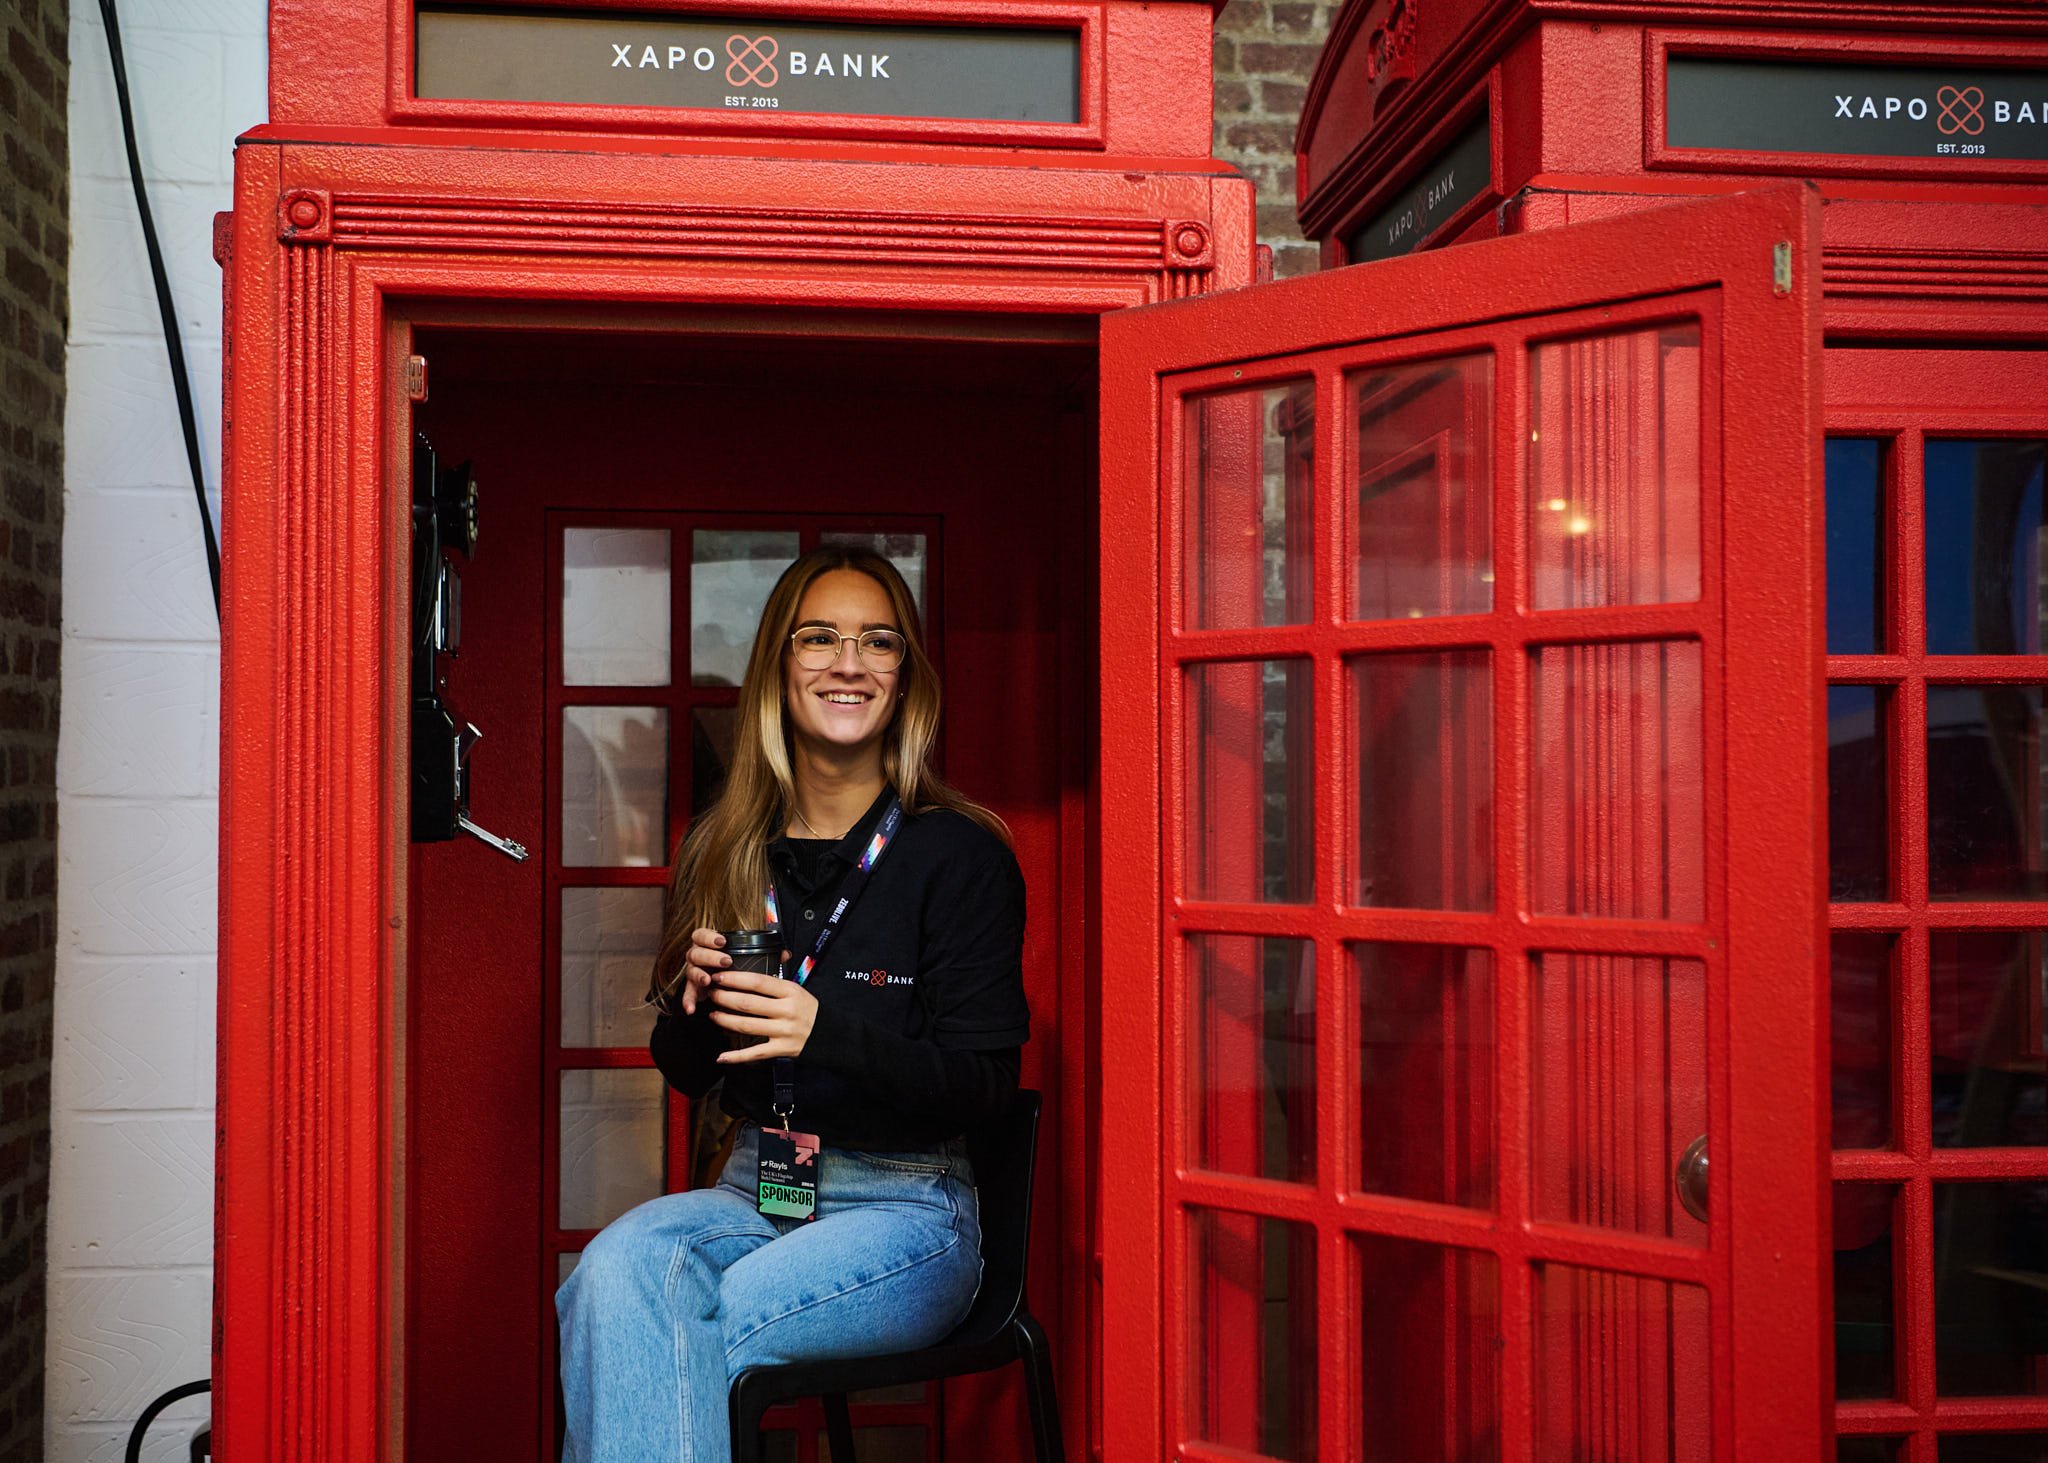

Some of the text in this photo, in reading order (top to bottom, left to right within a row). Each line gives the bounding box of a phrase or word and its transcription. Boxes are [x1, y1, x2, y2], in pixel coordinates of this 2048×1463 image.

[611, 44, 891, 79] XAPO BANK
[725, 96, 779, 108] EST. 2013
[1834, 95, 2048, 124] XAPO BA
[1936, 143, 1986, 154] EST. 2013
[1388, 170, 1455, 246] XAPO BANK
[844, 970, 914, 985] XAPO BANK
[768, 1160, 788, 1170] Rayls
[762, 1186, 813, 1206] SPONSOR
